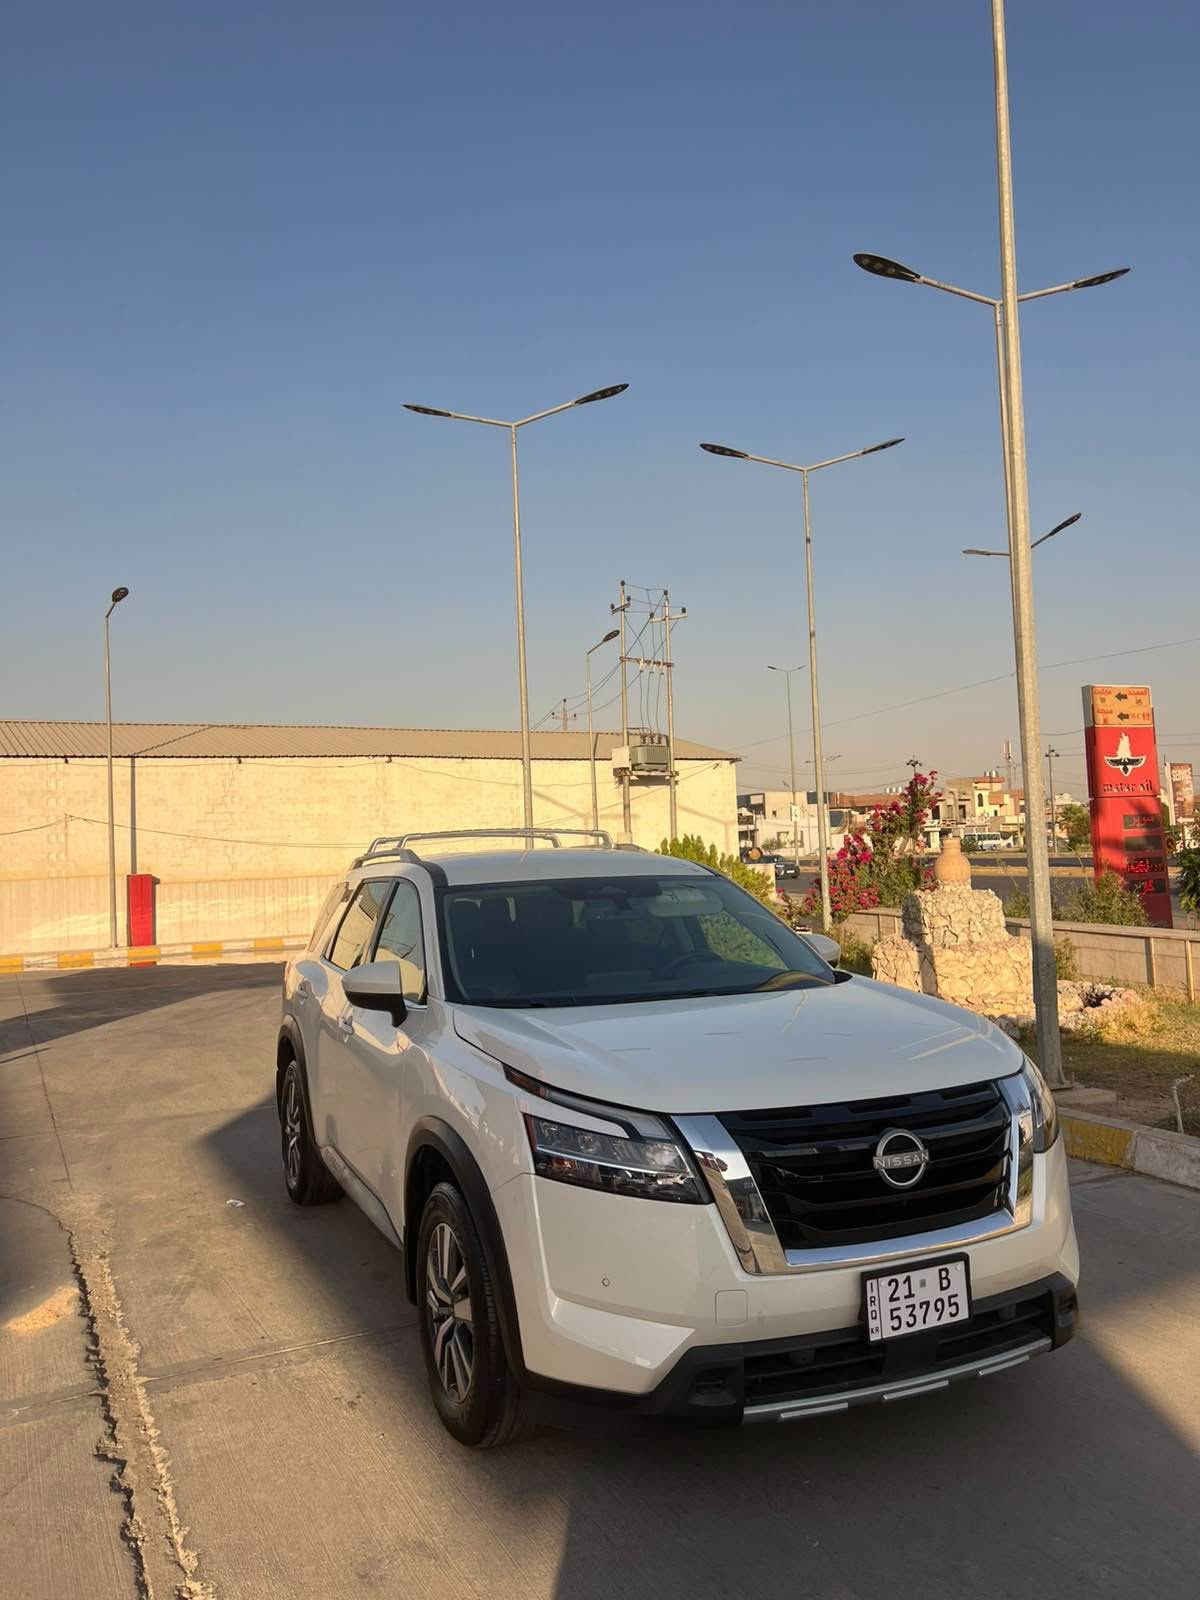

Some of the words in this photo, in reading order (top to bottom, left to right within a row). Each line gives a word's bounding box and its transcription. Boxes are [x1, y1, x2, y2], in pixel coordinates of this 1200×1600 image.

[874, 1150, 928, 1169] NISSAN
[887, 1275, 915, 1302] 21
[938, 1267, 951, 1291] B
[889, 1293, 960, 1331] 53795
